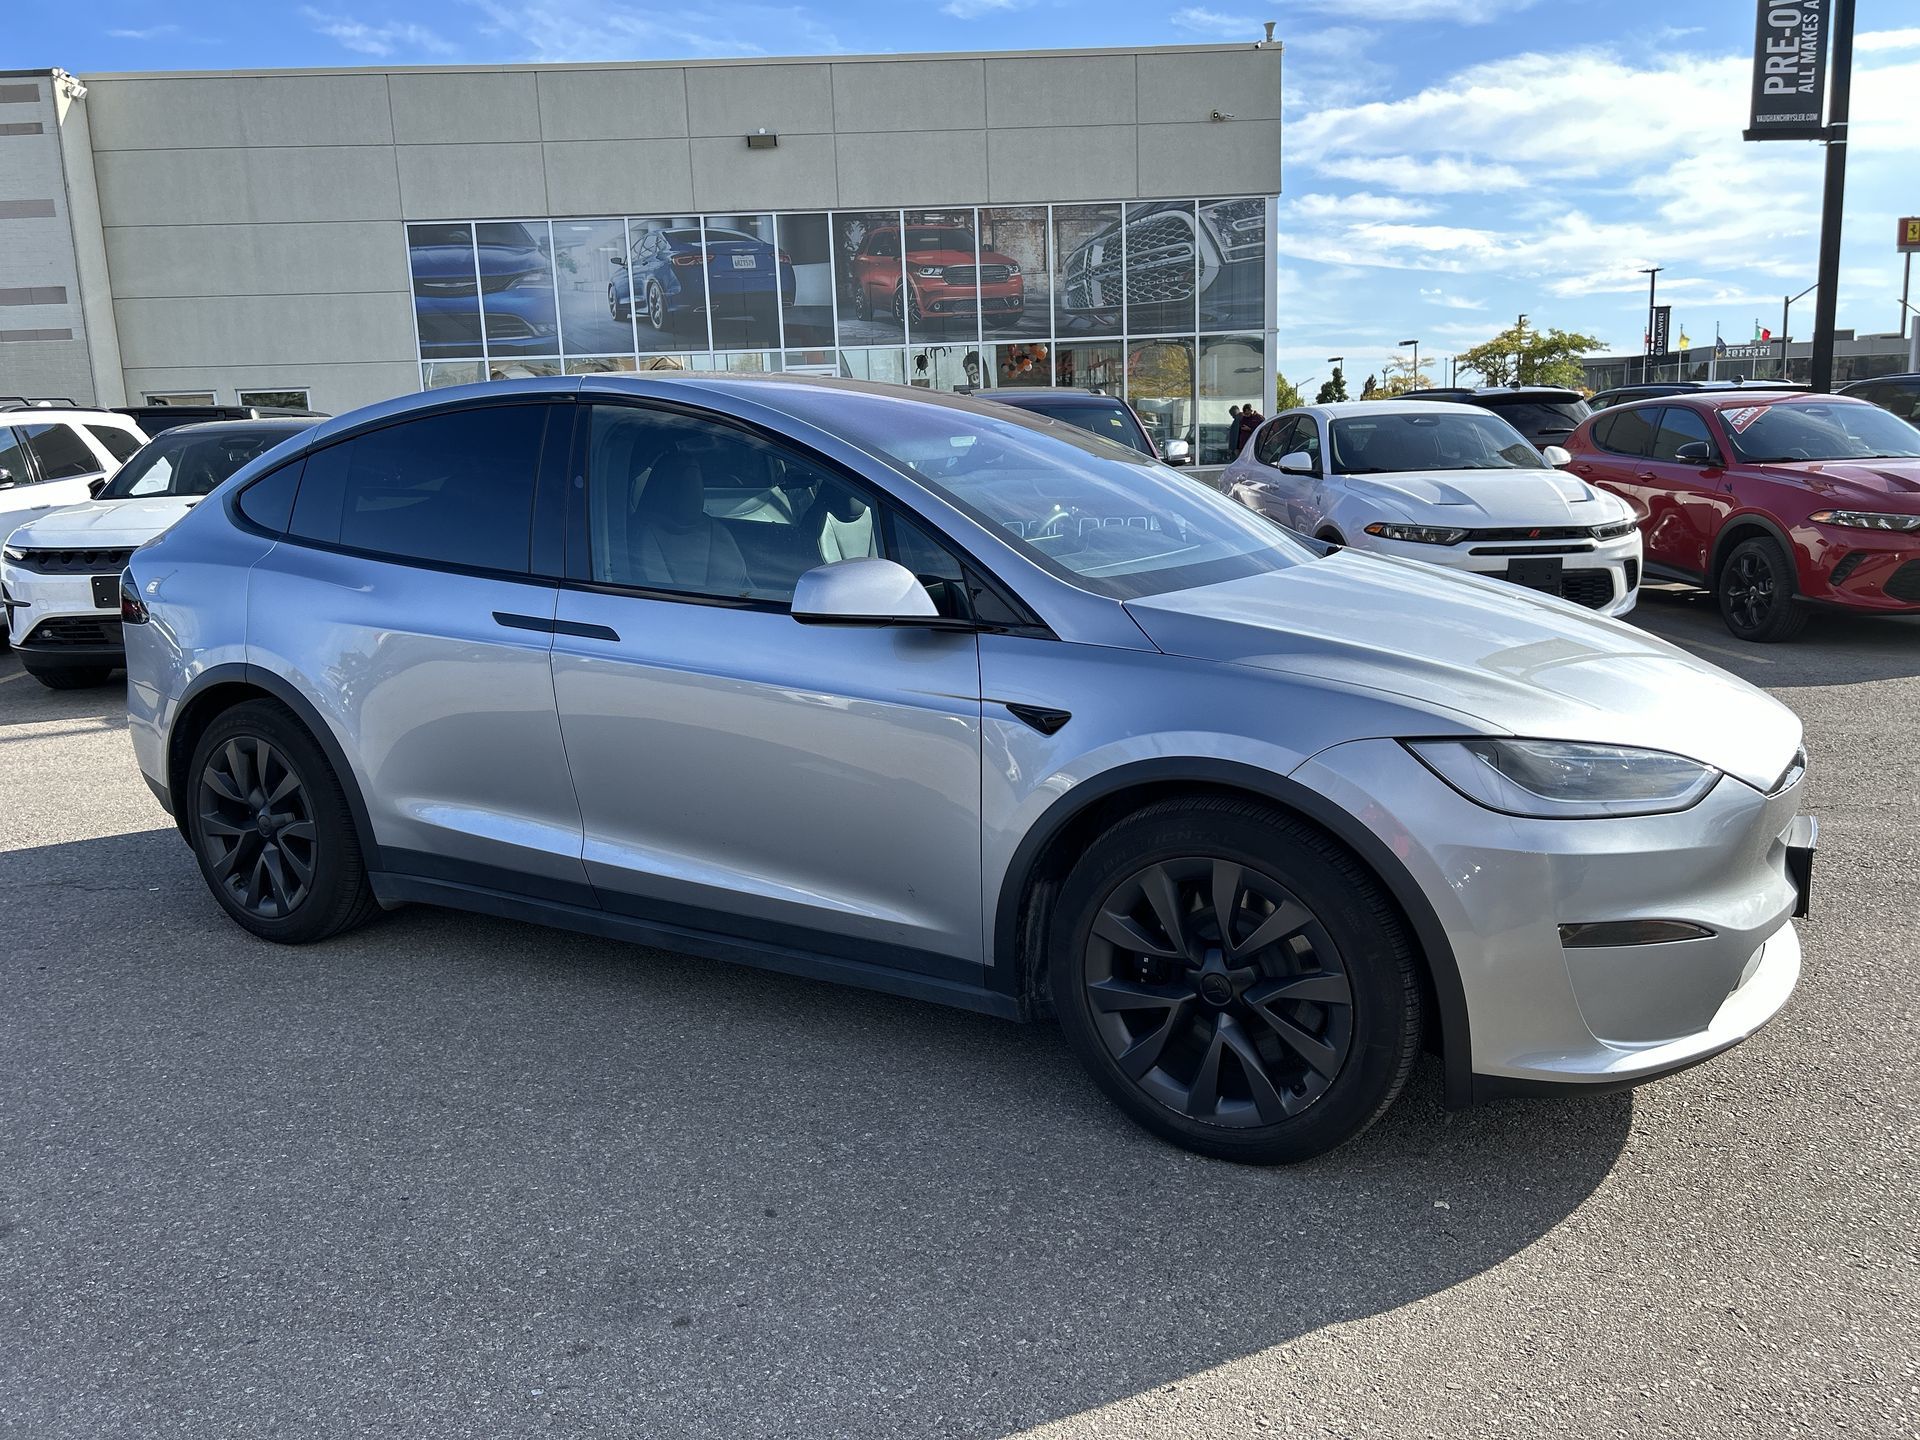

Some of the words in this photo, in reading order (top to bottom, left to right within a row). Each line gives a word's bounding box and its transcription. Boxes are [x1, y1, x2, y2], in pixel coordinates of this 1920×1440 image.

[1800, 14, 1819, 63] MAKES
[1798, 67, 1815, 93] ALL
[1656, 312, 1664, 347] DILAWRI
[1725, 346, 1770, 357] Ferrari
[1732, 407, 1759, 425] DEMO
